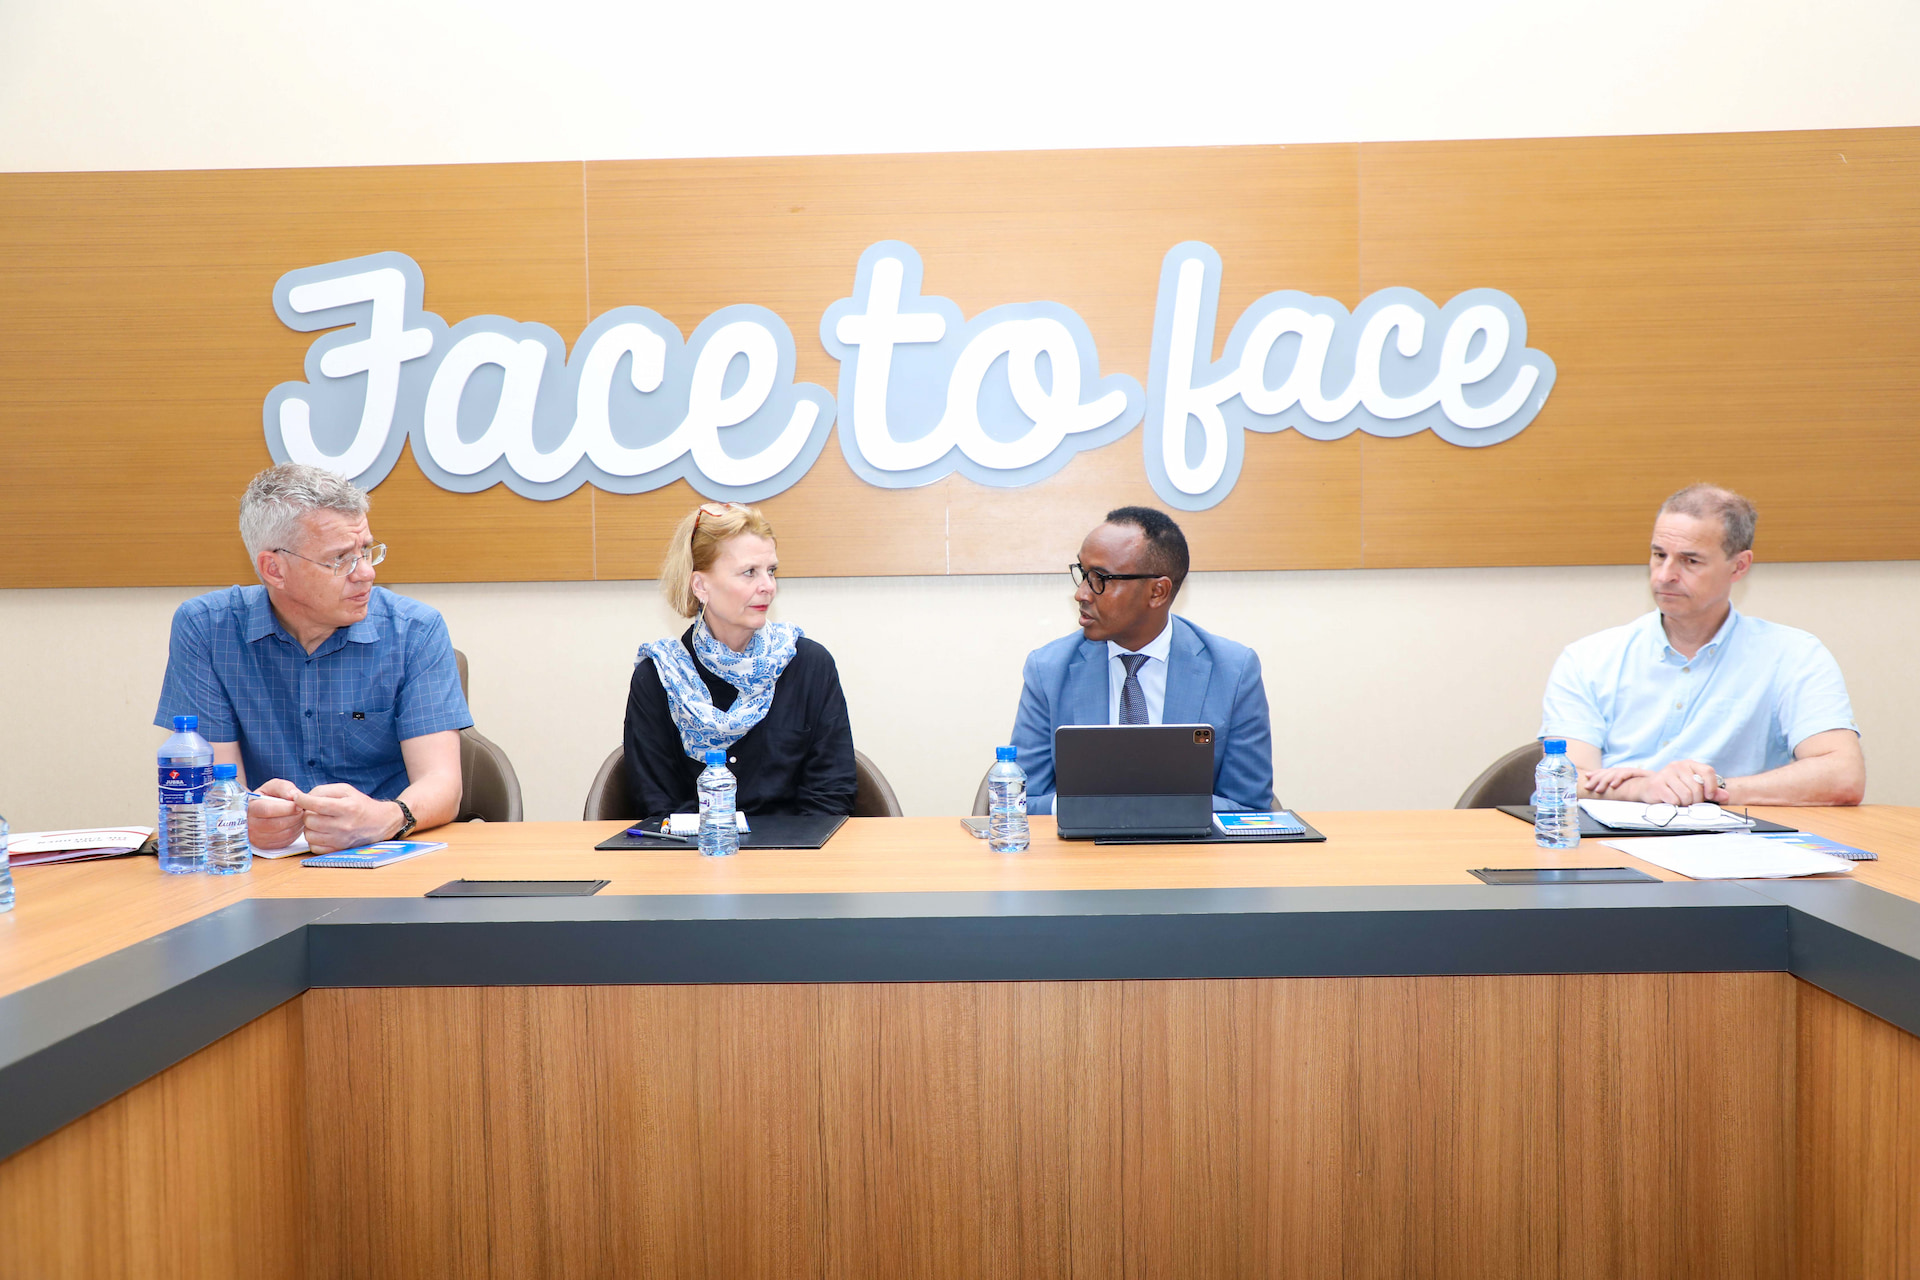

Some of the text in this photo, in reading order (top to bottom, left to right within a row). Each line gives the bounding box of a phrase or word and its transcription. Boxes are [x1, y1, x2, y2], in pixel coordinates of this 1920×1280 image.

[279, 256, 1541, 495] Face to face
